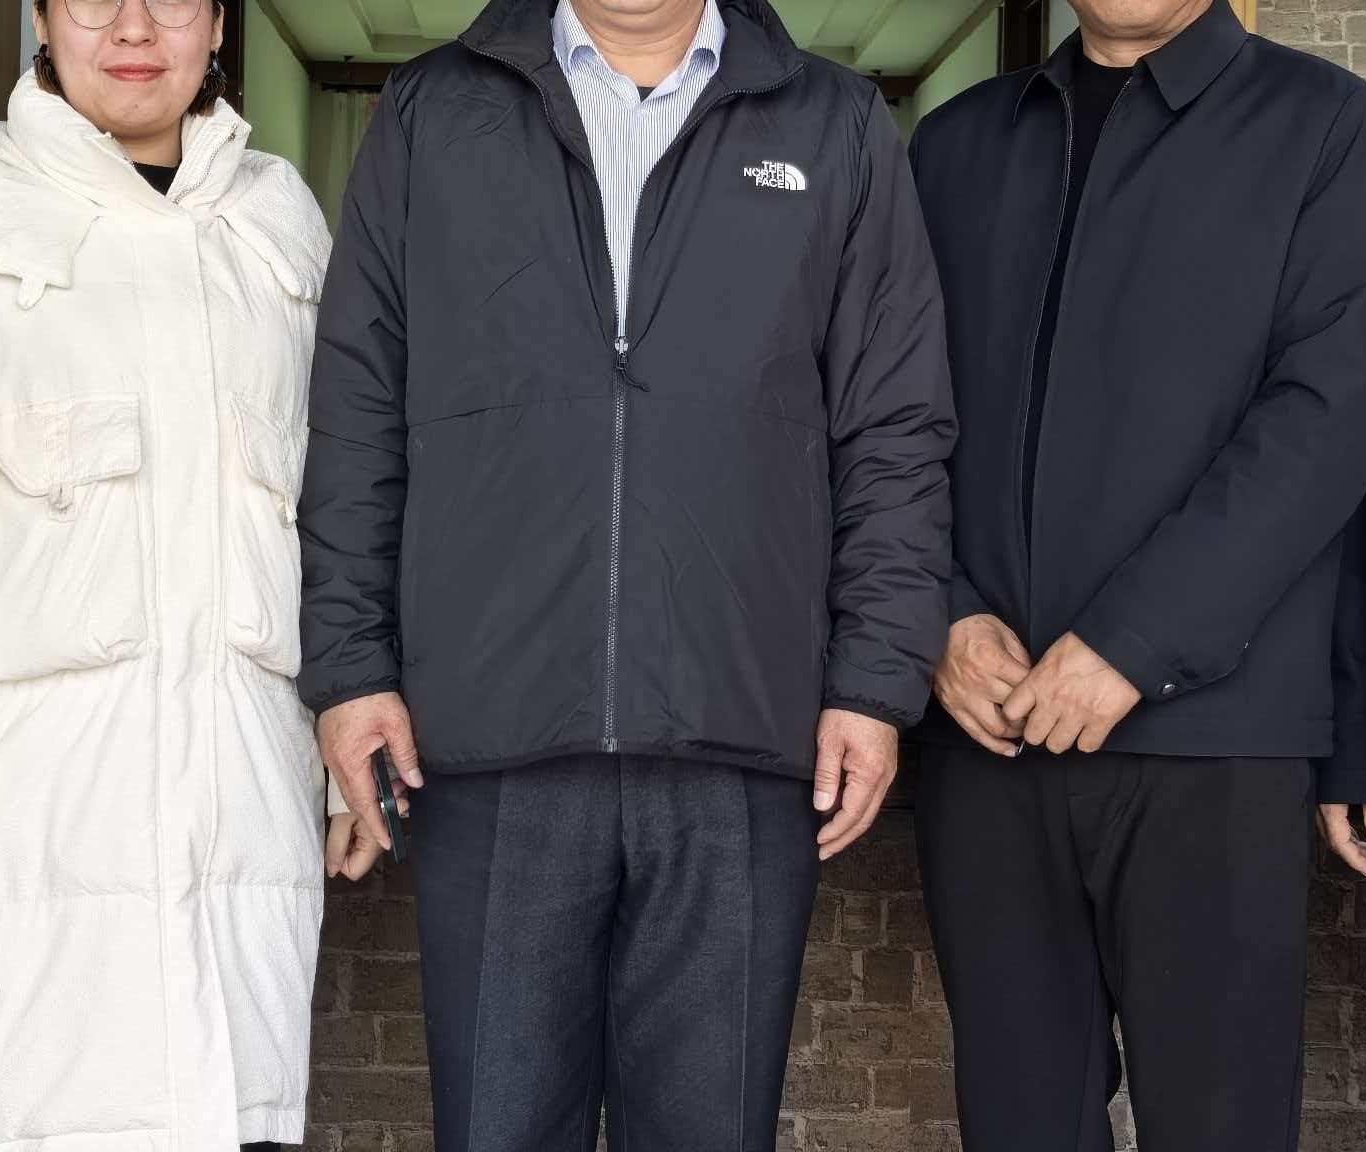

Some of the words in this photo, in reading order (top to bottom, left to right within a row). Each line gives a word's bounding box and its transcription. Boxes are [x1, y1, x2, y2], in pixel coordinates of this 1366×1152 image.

[762, 161, 784, 170] THE
[743, 168, 784, 180] NORTH
[756, 177, 784, 189] FACE
